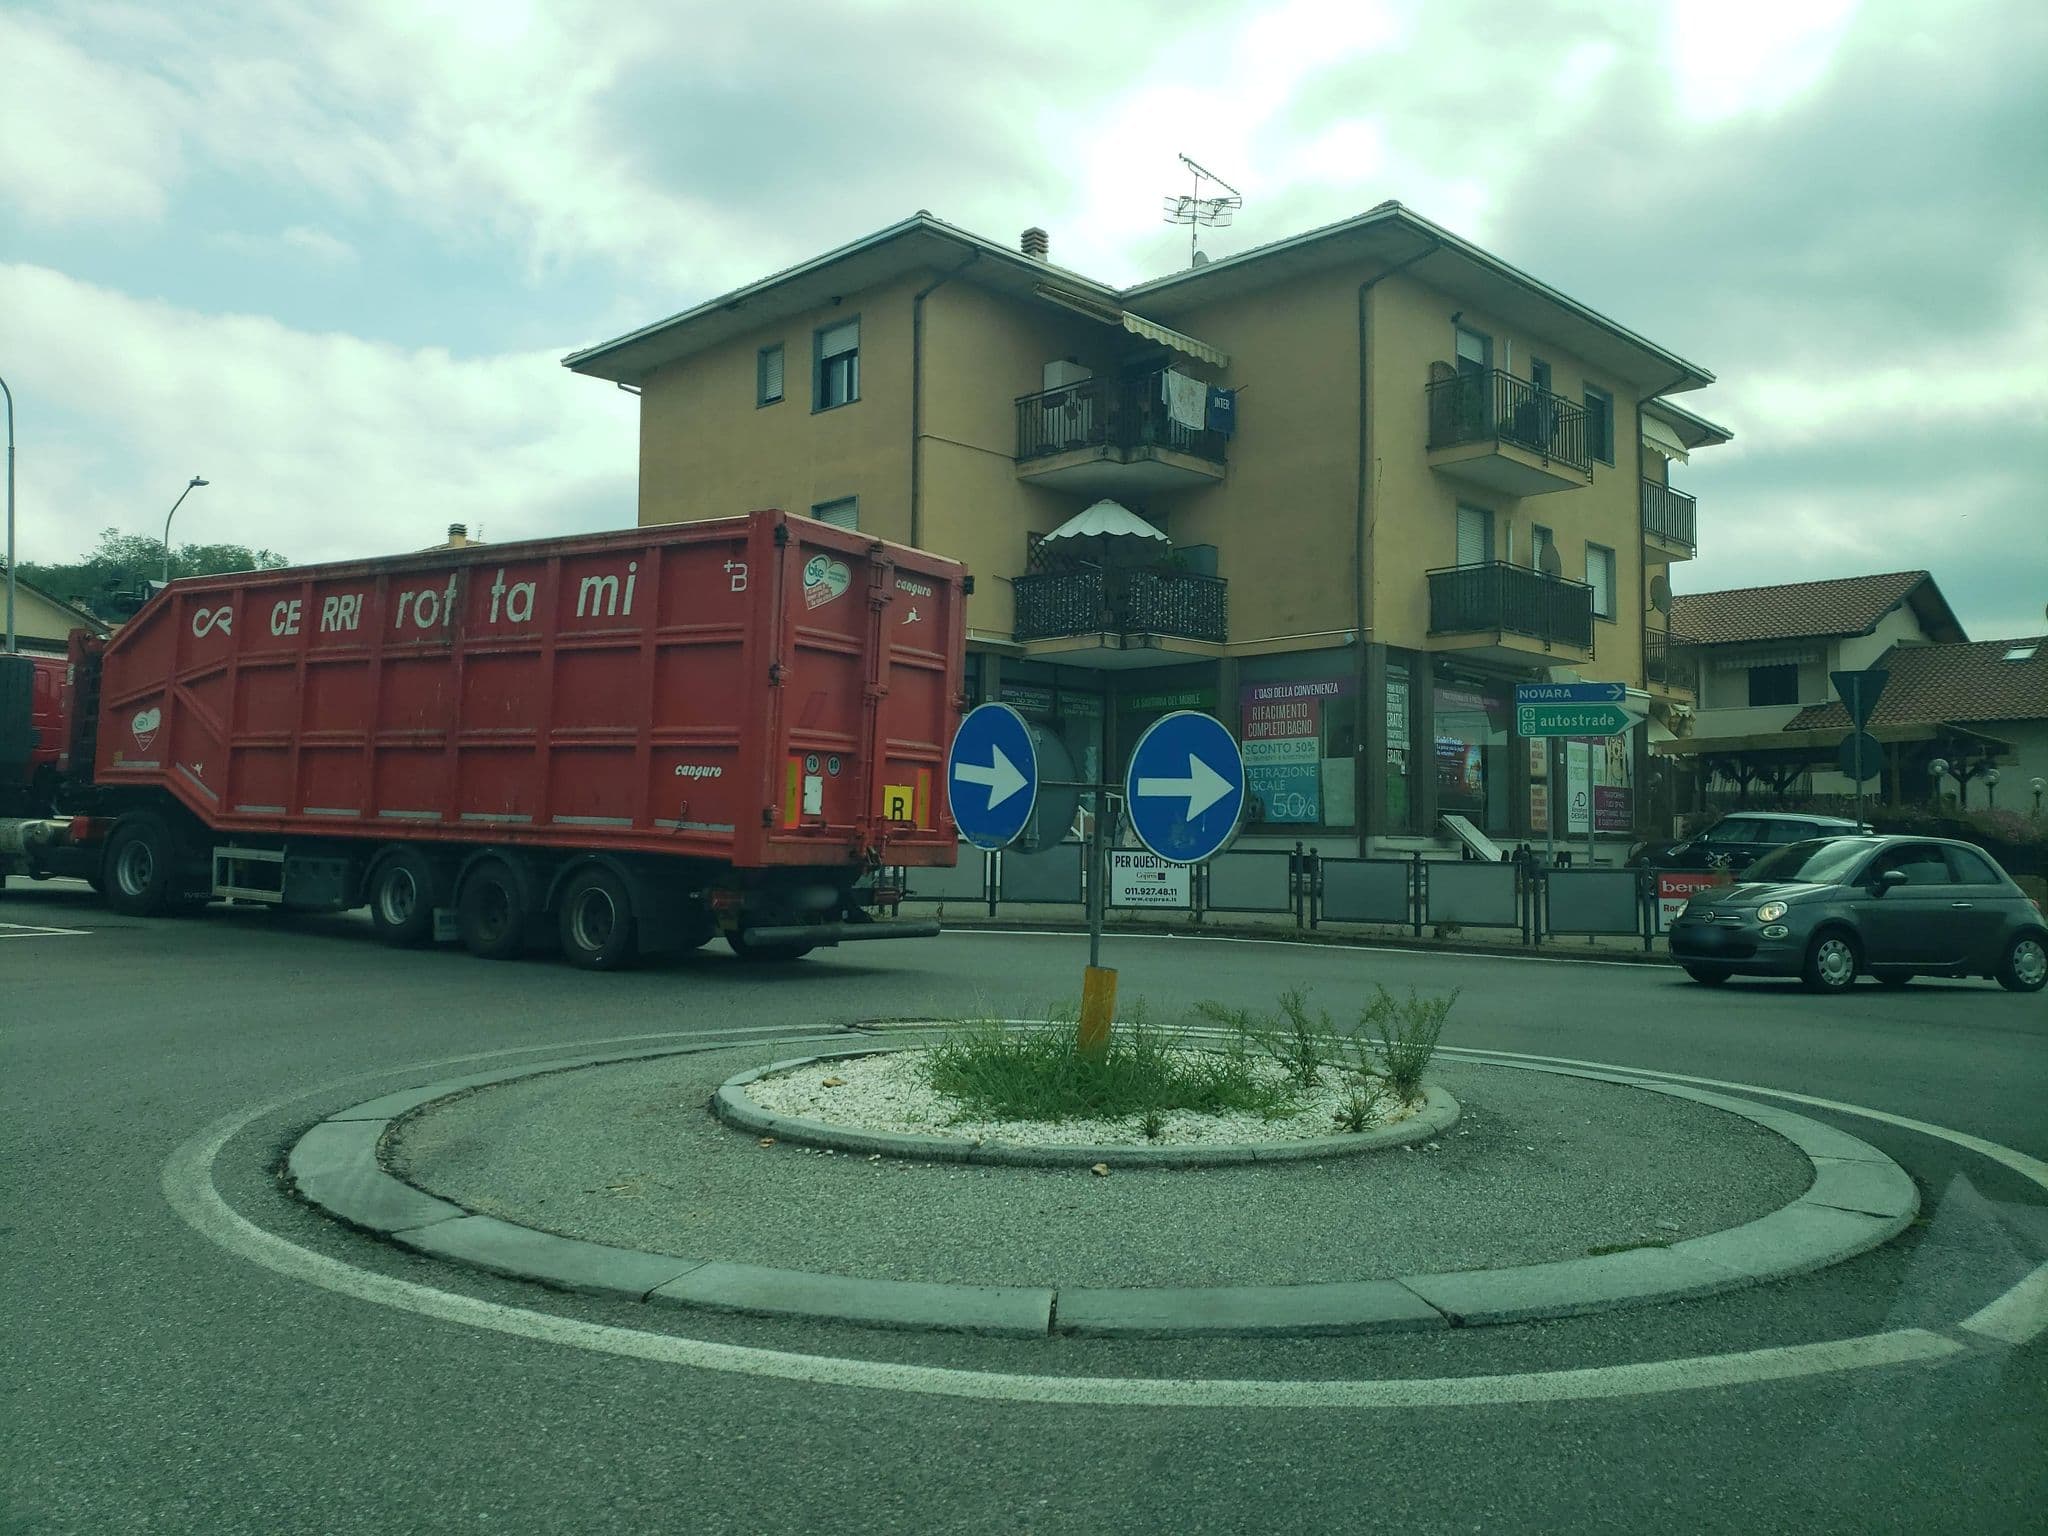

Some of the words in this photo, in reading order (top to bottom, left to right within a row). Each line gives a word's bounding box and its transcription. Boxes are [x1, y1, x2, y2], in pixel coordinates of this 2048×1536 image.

[1214, 396, 1230, 410] INTER
[896, 579, 932, 597] canguro
[1274, 686, 1293, 698] DELLA
[1294, 682, 1339, 697] CONVENIENZA
[1519, 688, 1572, 699] NOVARA
[1252, 703, 1308, 721] RIFACIMENTO
[1540, 713, 1615, 727] autostrade
[1248, 721, 1286, 737] COMPLETO
[1287, 719, 1312, 735] BAGNO
[1245, 742, 1291, 755] SCONTO
[1295, 740, 1316, 753] 50%
[675, 764, 722, 780] canguro
[1246, 766, 1316, 779] DETRAZIONE
[1248, 779, 1287, 791] ISCALE
[892, 796, 904, 820] R
[1272, 792, 1316, 817] 50%
[1115, 855, 1131, 868] PER
[1133, 855, 1162, 869] QUESTI
[1124, 887, 1177, 896] 011.927.48.11
